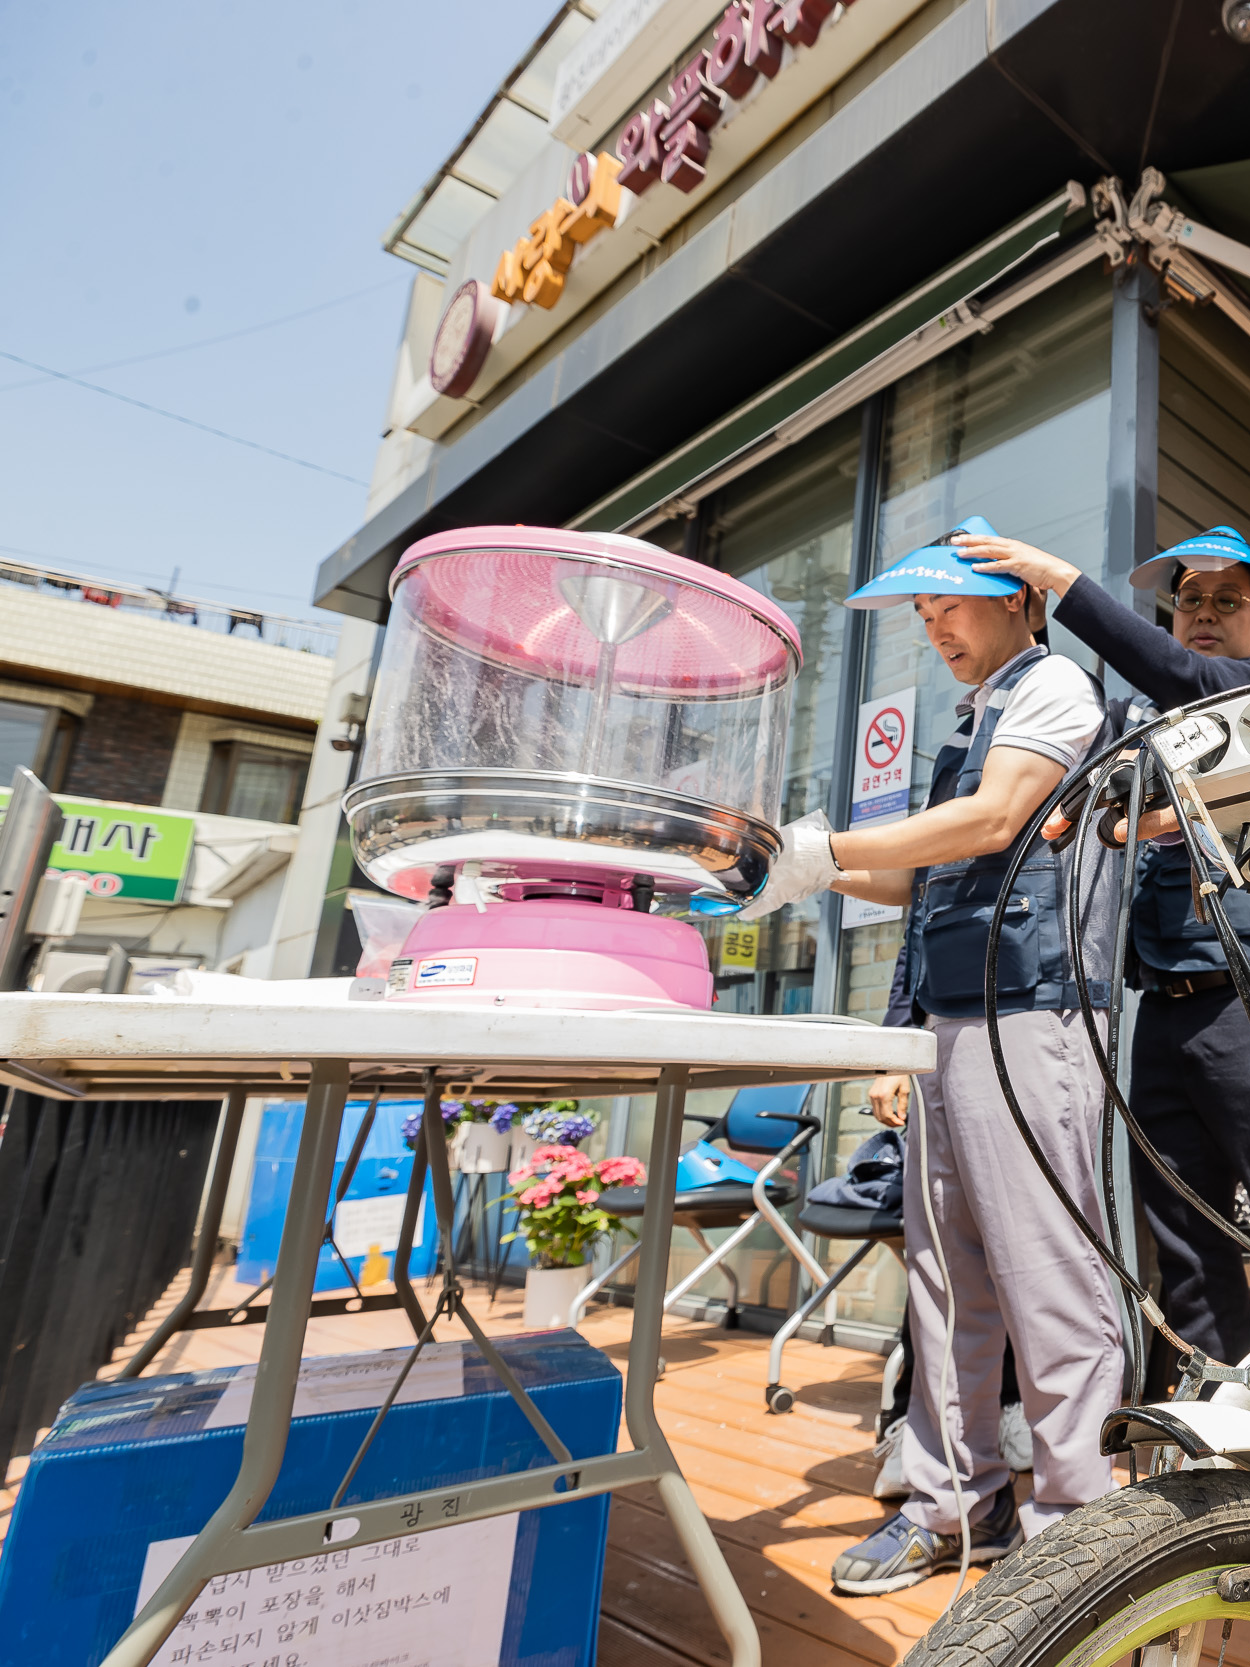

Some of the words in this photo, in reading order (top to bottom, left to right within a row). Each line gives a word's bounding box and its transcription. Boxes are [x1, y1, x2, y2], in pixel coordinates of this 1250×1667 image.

[861, 767, 903, 793] 금연구역
[361, 1536, 421, 1561] 그대로
[257, 1585, 325, 1615] 포장을
[336, 1573, 377, 1598] 해서
[170, 1629, 262, 1665] 파손되지
[277, 1616, 319, 1644] 않게
[331, 1585, 452, 1627] 이삿짐박스에
